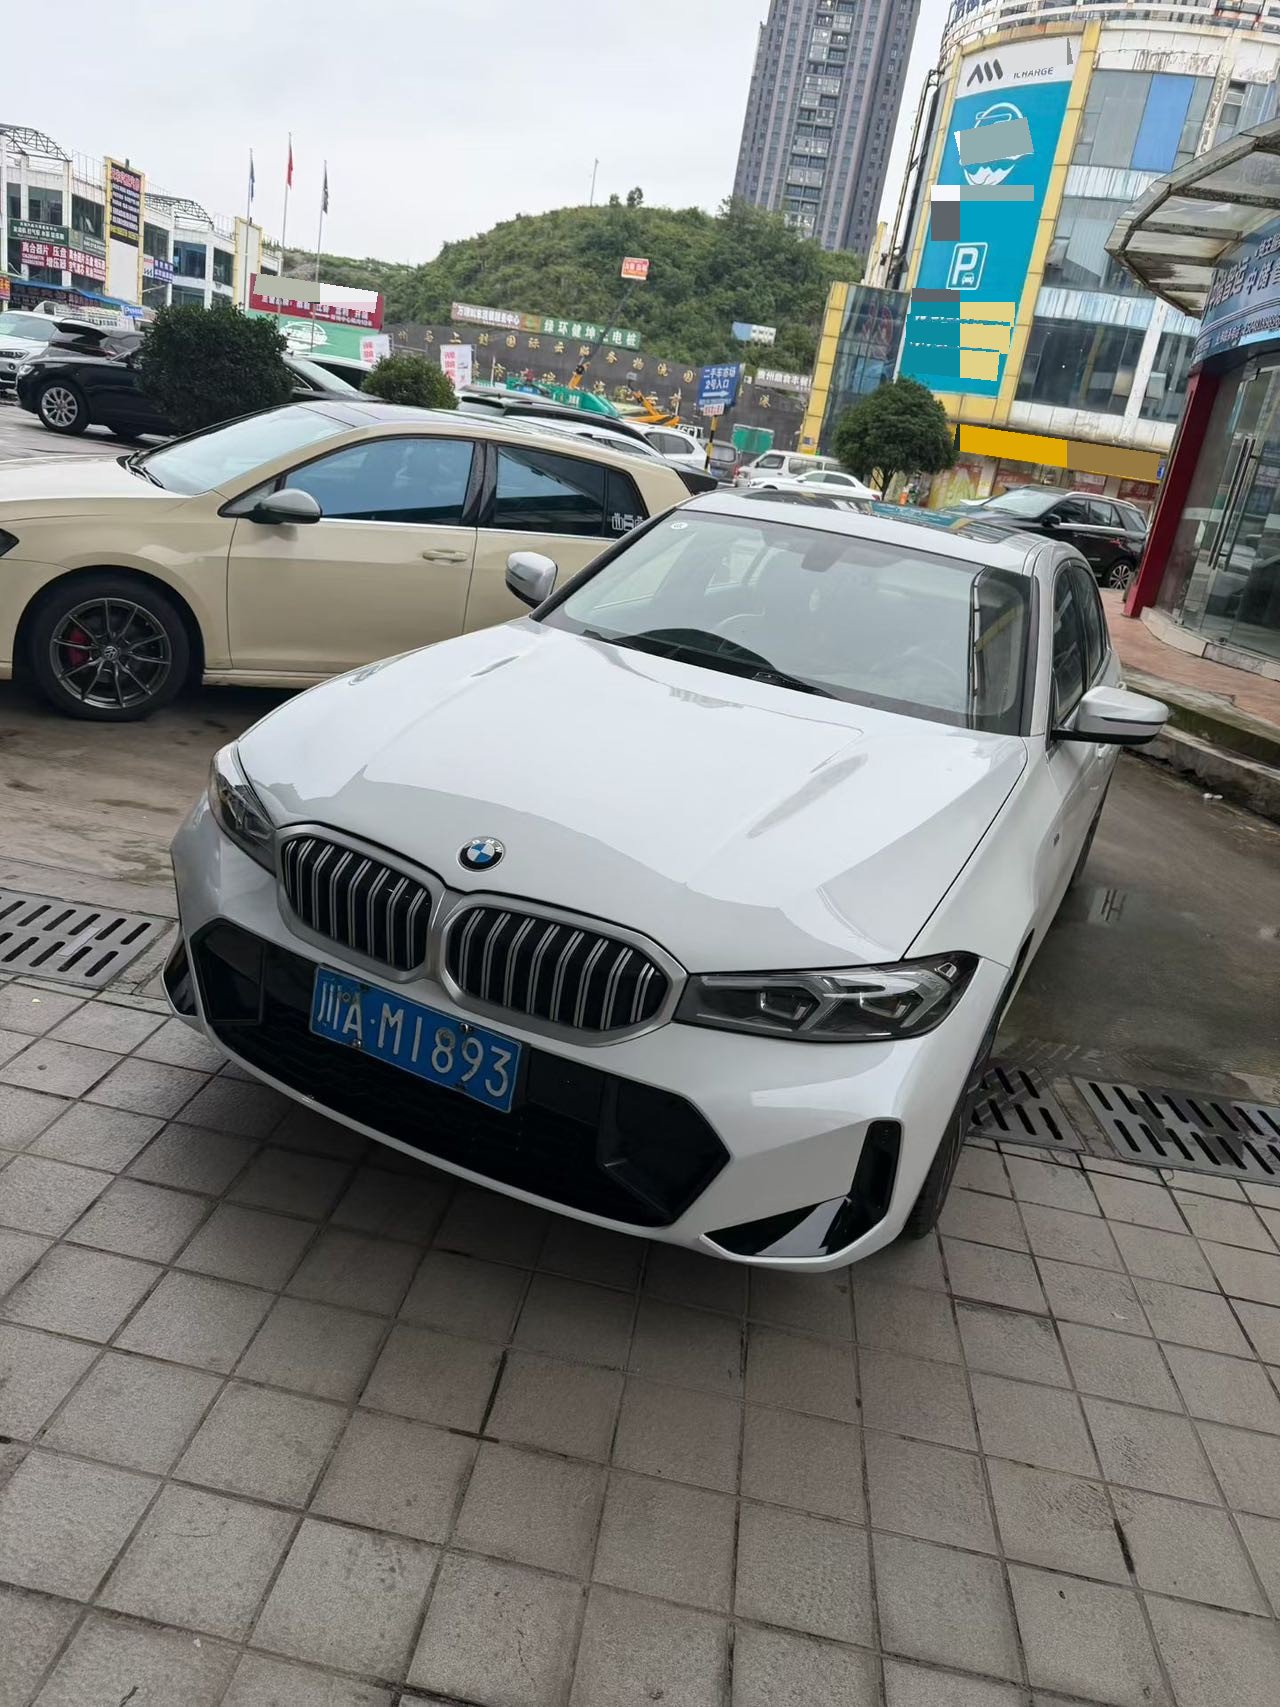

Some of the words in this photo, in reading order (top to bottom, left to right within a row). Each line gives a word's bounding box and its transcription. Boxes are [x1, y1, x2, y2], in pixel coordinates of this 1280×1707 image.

[22, 242, 49, 255] 离合器片
[53, 246, 67, 258] 压盘
[703, 366, 736, 379] 二手车市场
[704, 378, 729, 391] 2号入口
